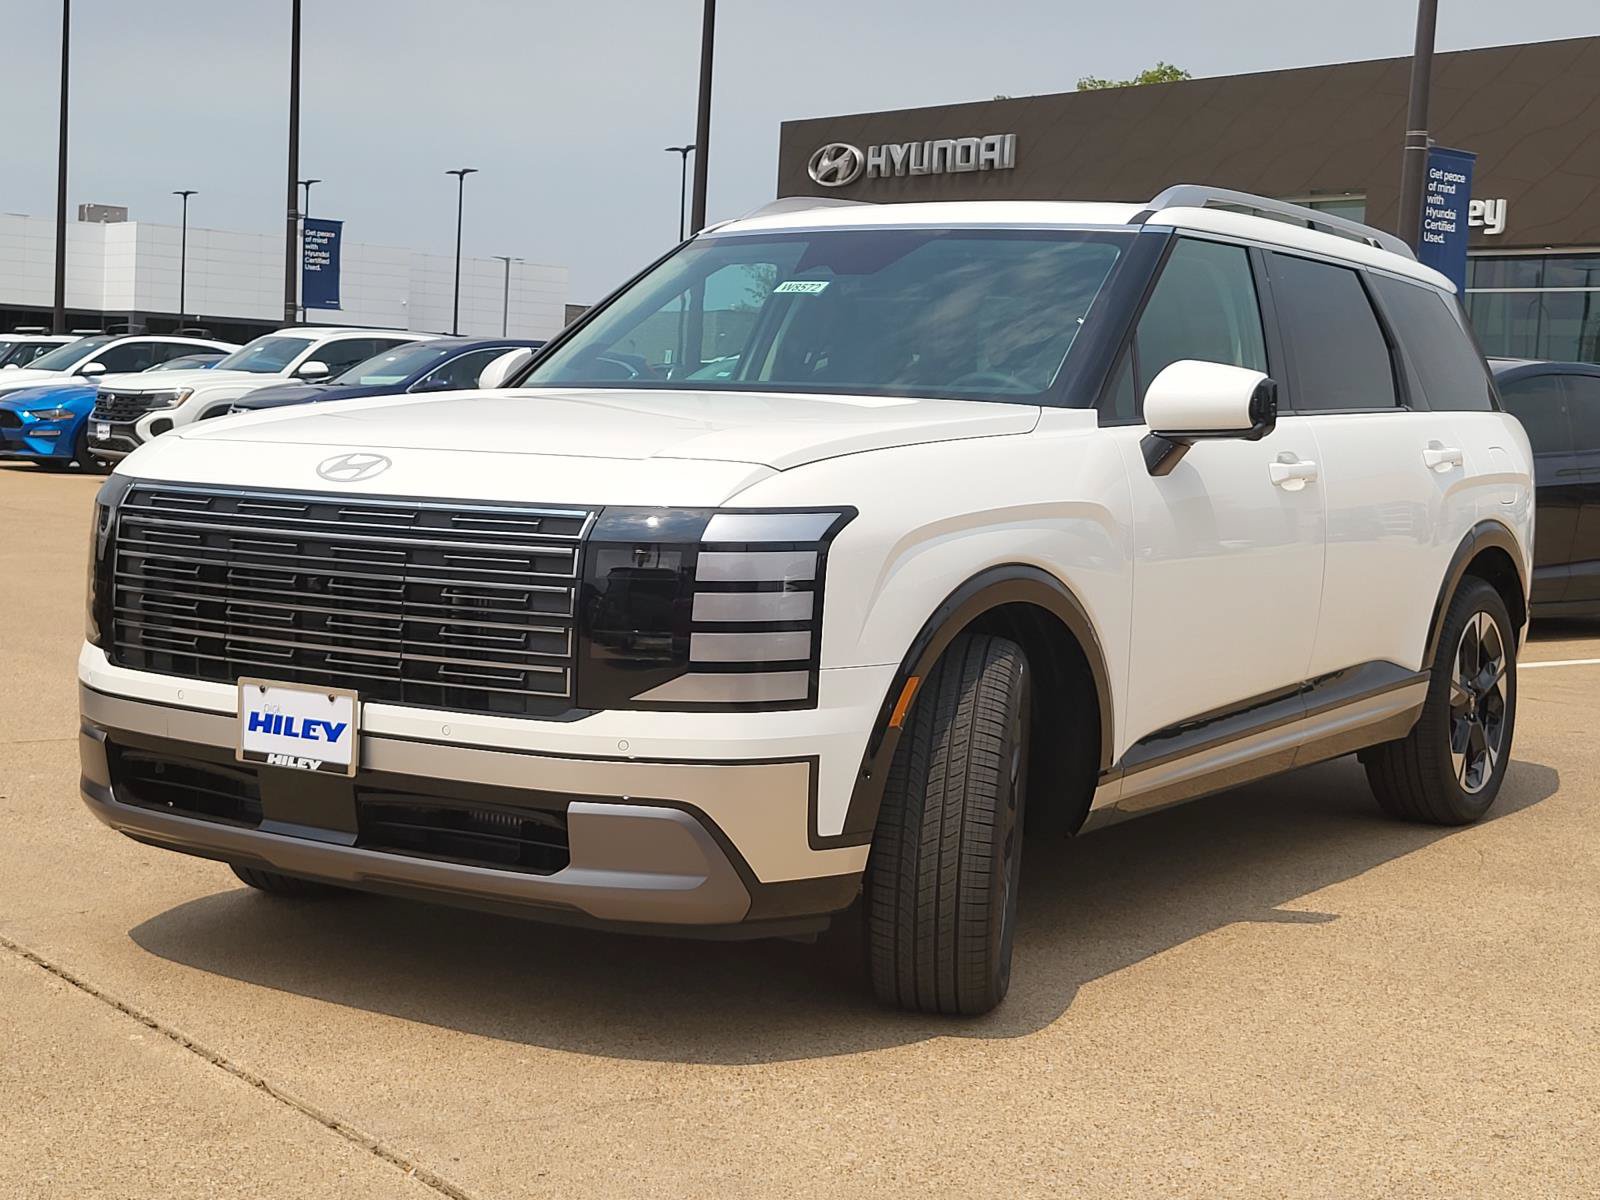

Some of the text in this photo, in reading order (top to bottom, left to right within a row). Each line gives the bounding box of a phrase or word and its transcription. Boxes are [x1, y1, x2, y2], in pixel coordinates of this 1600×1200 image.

[866, 134, 1017, 178] HYUNDAI
[1429, 168, 1466, 183] Get peace
[1428, 181, 1456, 194] of mind
[1426, 193, 1444, 205] with
[1425, 206, 1457, 220] Hyundai
[1467, 198, 1507, 235] ey
[1424, 219, 1456, 233] Certified
[317, 230, 336, 238] peace
[1423, 231, 1446, 244] Used.
[304, 250, 330, 258] Hyundai
[304, 256, 330, 265] Certified
[304, 263, 322, 271] Used.
[247, 711, 348, 743] HILEY
[266, 753, 322, 770] HILEY
